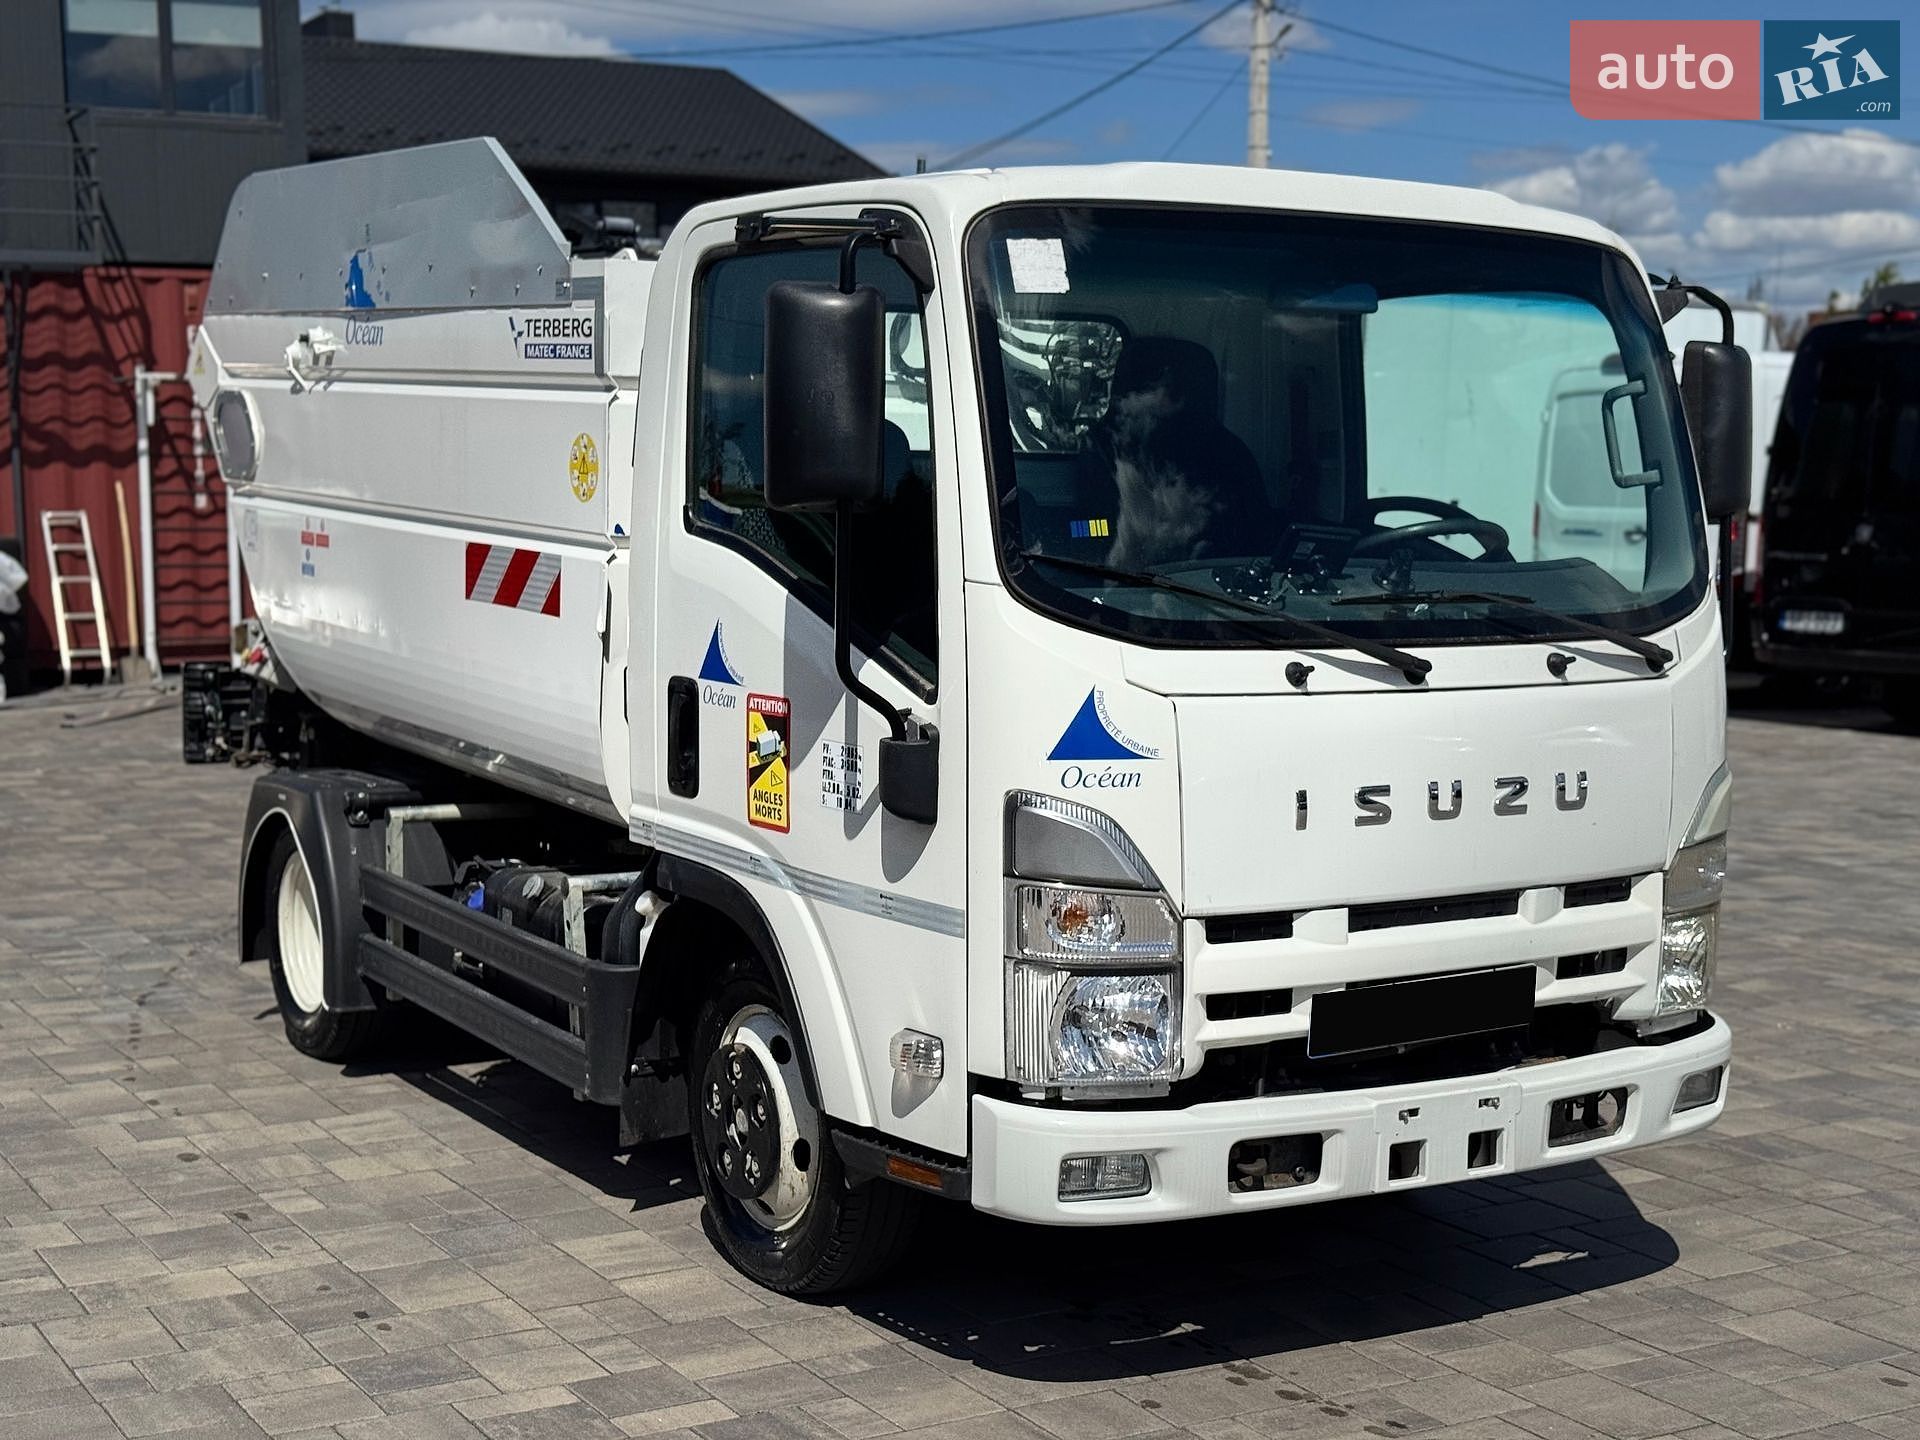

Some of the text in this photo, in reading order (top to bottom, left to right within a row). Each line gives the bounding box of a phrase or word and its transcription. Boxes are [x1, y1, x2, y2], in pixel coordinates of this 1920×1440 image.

[346, 315, 384, 346] Océan
[525, 318, 592, 338] TERBERG
[527, 345, 590, 358] MATEC FRANCE
[703, 685, 736, 709] Océan
[749, 697, 787, 714] ATTENTION
[1121, 735, 1160, 757] URBAINE
[1060, 766, 1142, 789] Océan
[753, 788, 783, 806] ANGLES
[1295, 770, 1589, 831] ISUZU
[755, 804, 782, 821] MORTS
